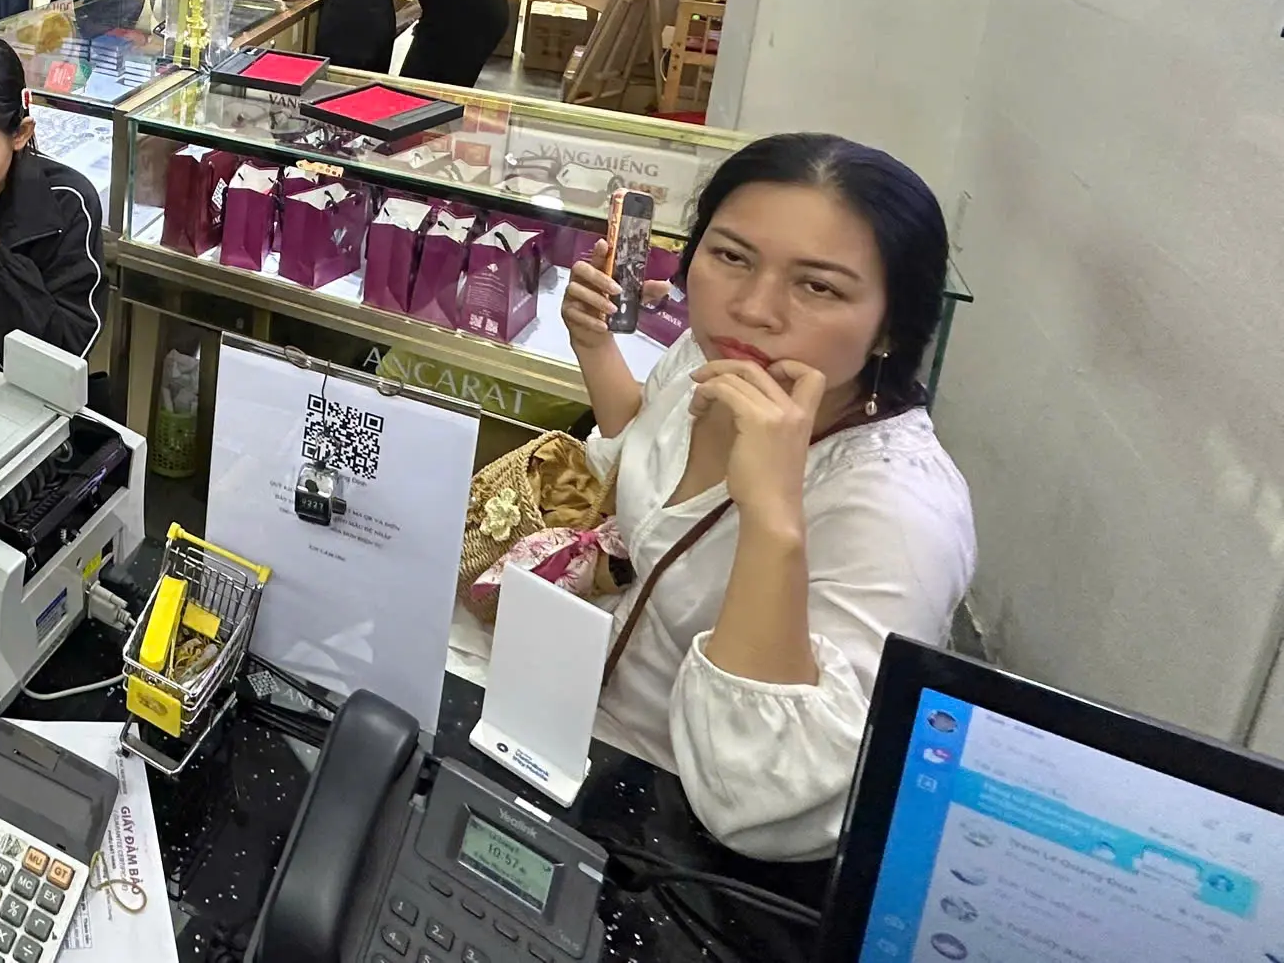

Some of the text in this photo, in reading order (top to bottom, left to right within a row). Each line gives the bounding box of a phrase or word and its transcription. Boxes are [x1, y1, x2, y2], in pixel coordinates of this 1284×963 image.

[594, 153, 659, 177] MIẾNG
[362, 346, 531, 415] ANCARAT
[120, 806, 135, 834] GIẤY
[499, 808, 537, 838] Yealink
[124, 835, 139, 864] ĐẢM
[488, 843, 519, 869] 10:57
[29, 853, 42, 866] MU
[54, 866, 67, 878] GT
[18, 876, 32, 890] MC
[43, 889, 57, 904] EX
[432, 925, 439, 935] 2
[466, 949, 474, 959] 3
